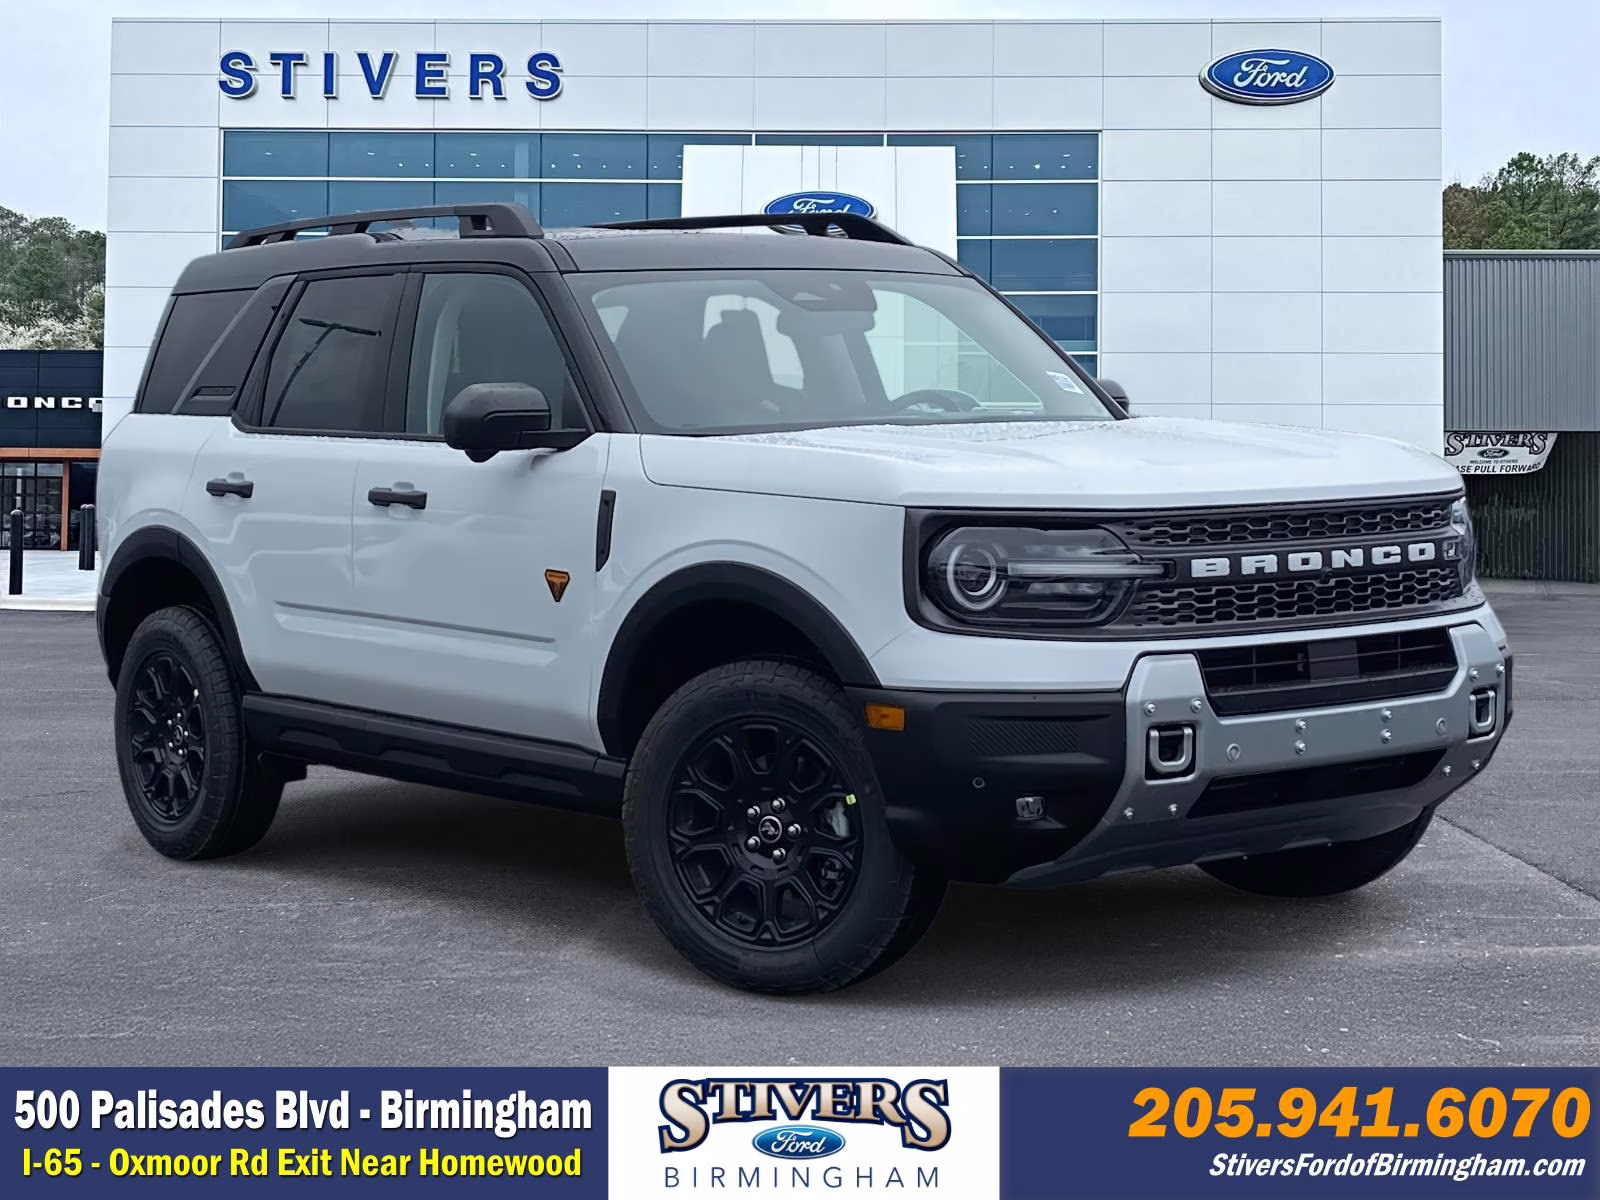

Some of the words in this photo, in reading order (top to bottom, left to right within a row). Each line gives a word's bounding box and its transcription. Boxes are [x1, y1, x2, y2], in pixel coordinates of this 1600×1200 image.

[218, 50, 563, 100] STIVERS
[1233, 58, 1309, 88] Ford
[1445, 432, 1548, 456] STIVERS
[1483, 449, 1504, 457] Ford
[1474, 465, 1497, 473] PULL
[1190, 542, 1436, 578] BRONCO
